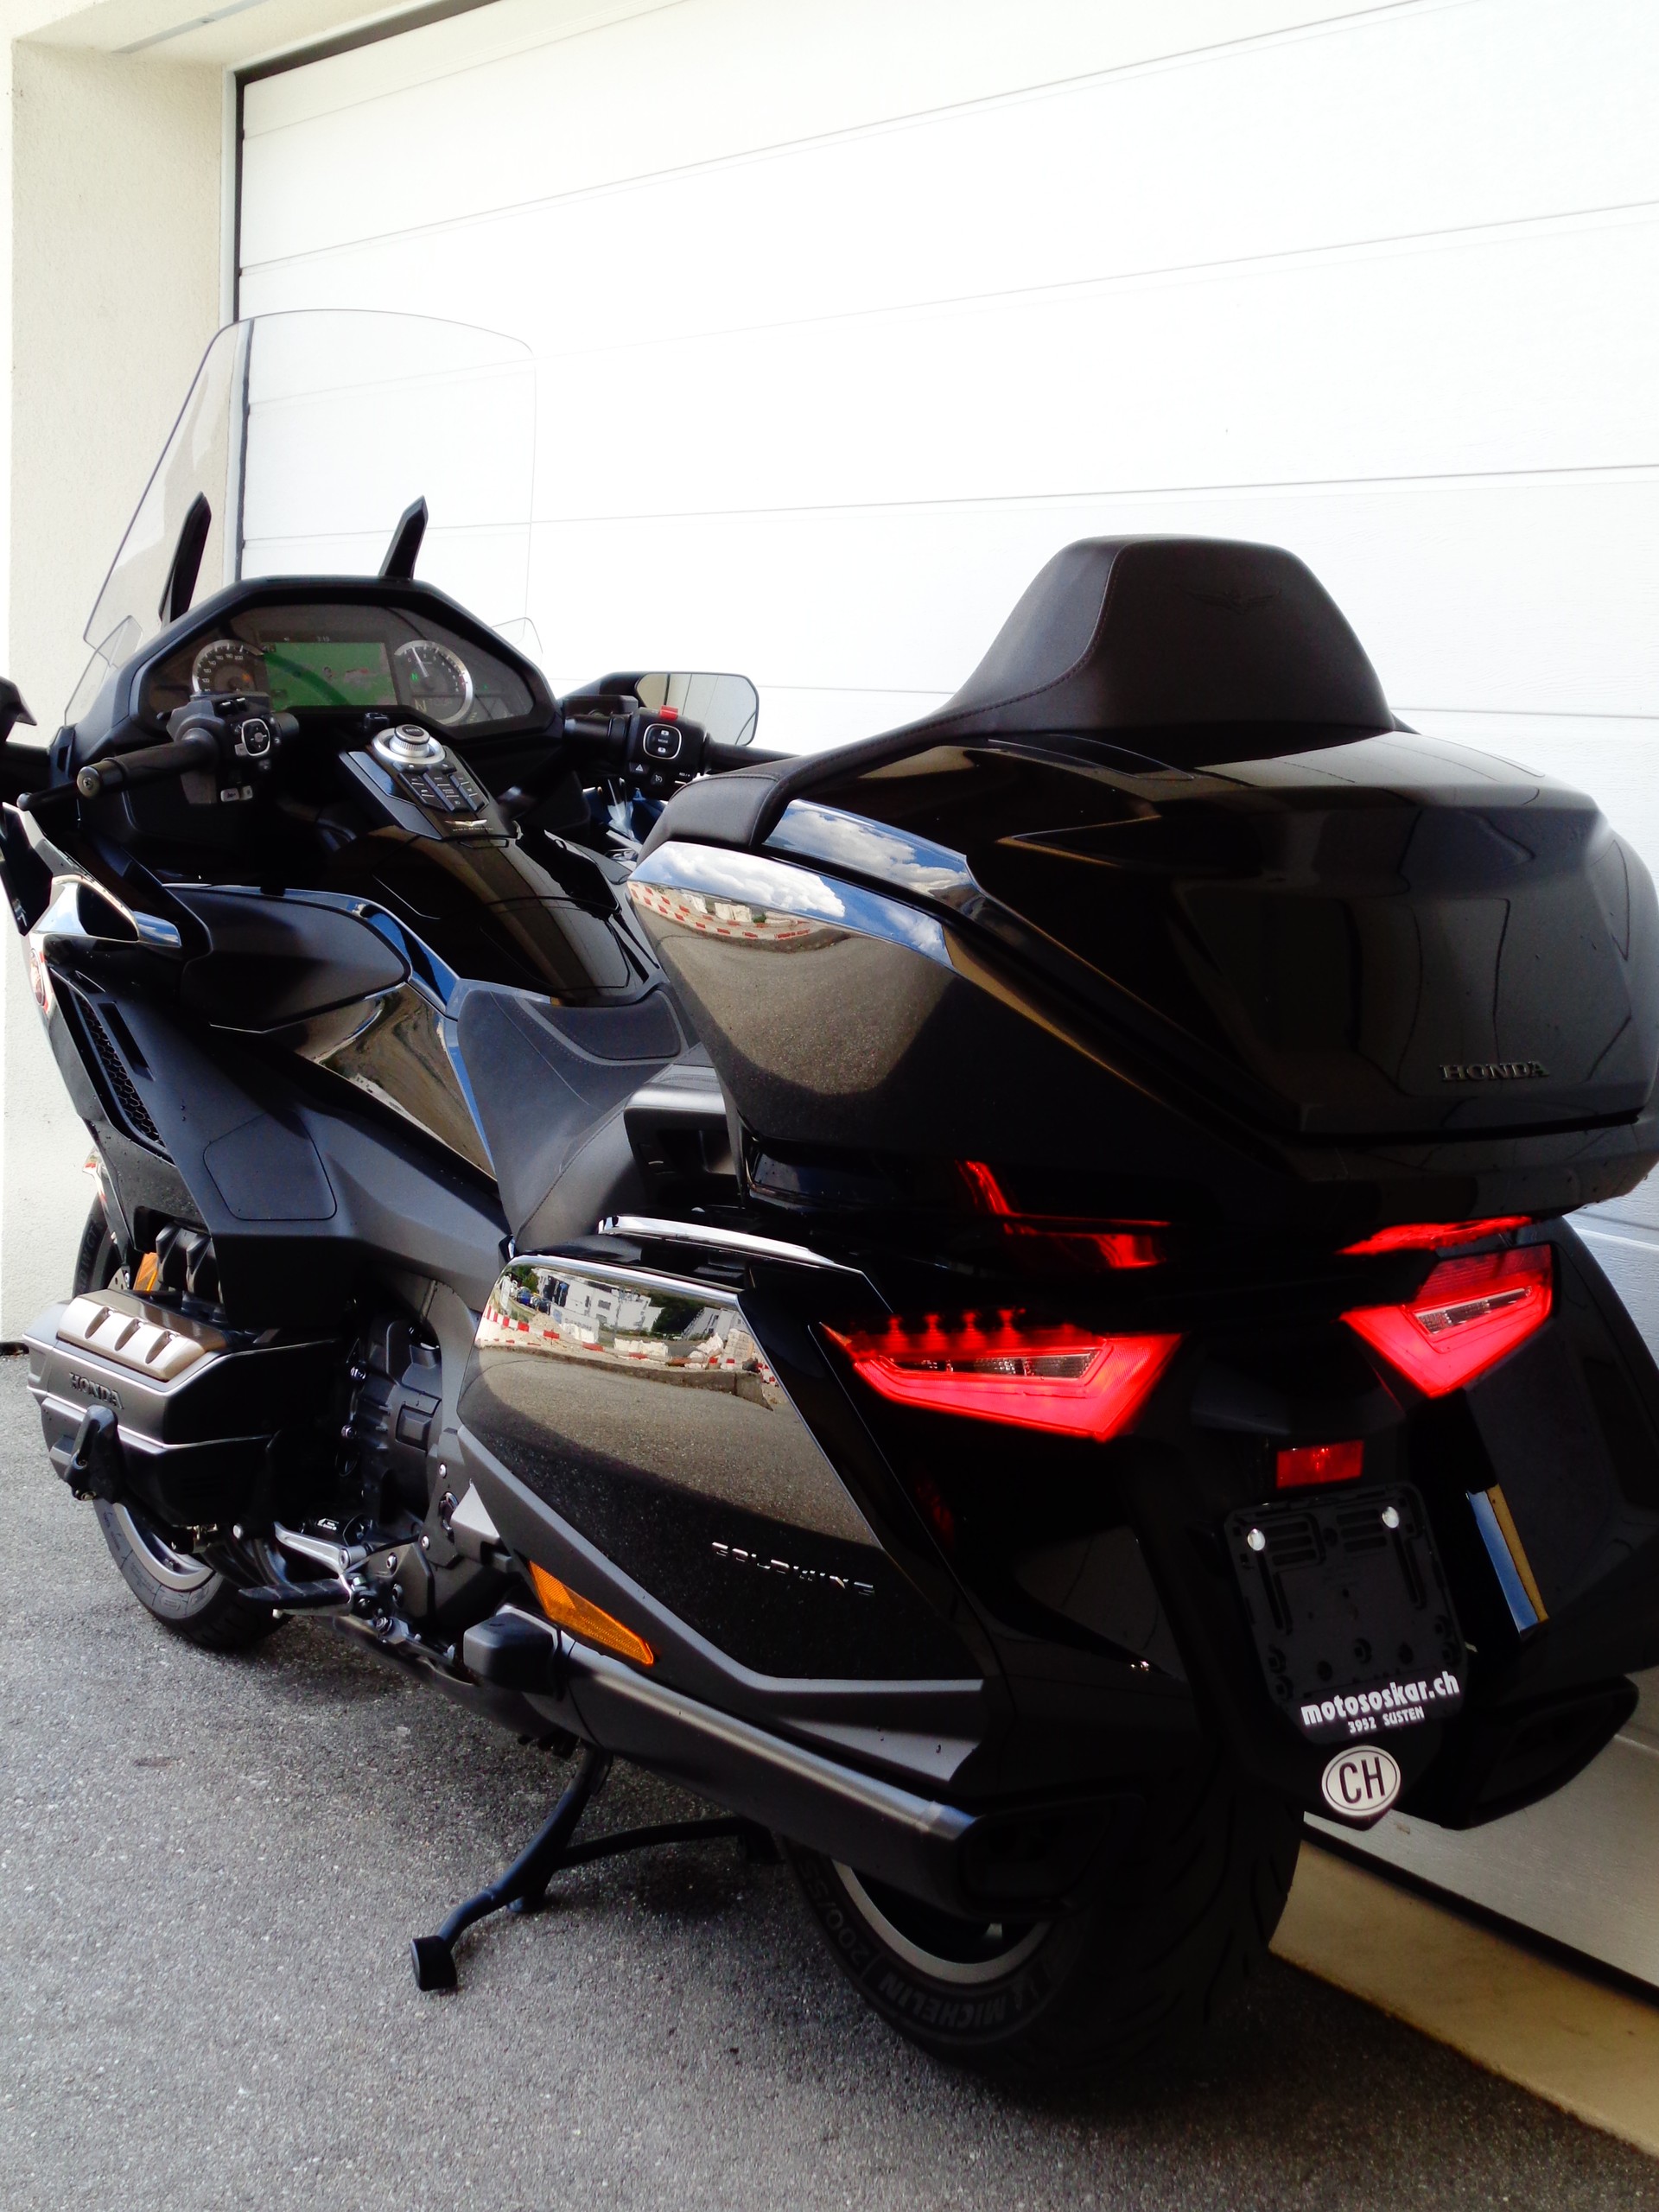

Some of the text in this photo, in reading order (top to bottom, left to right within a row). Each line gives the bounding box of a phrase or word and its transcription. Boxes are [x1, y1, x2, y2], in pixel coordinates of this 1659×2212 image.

[1439, 1060, 1549, 1082] HONDA
[69, 1372, 124, 1409] HONDA
[1300, 1670, 1460, 1726] motososkar.ch
[1348, 1706, 1425, 1734] 3952 SUSTEN
[1339, 1756, 1386, 1804] CH
[796, 1859, 869, 1966] 200/55
[878, 1971, 1007, 2028] MICHELIN
